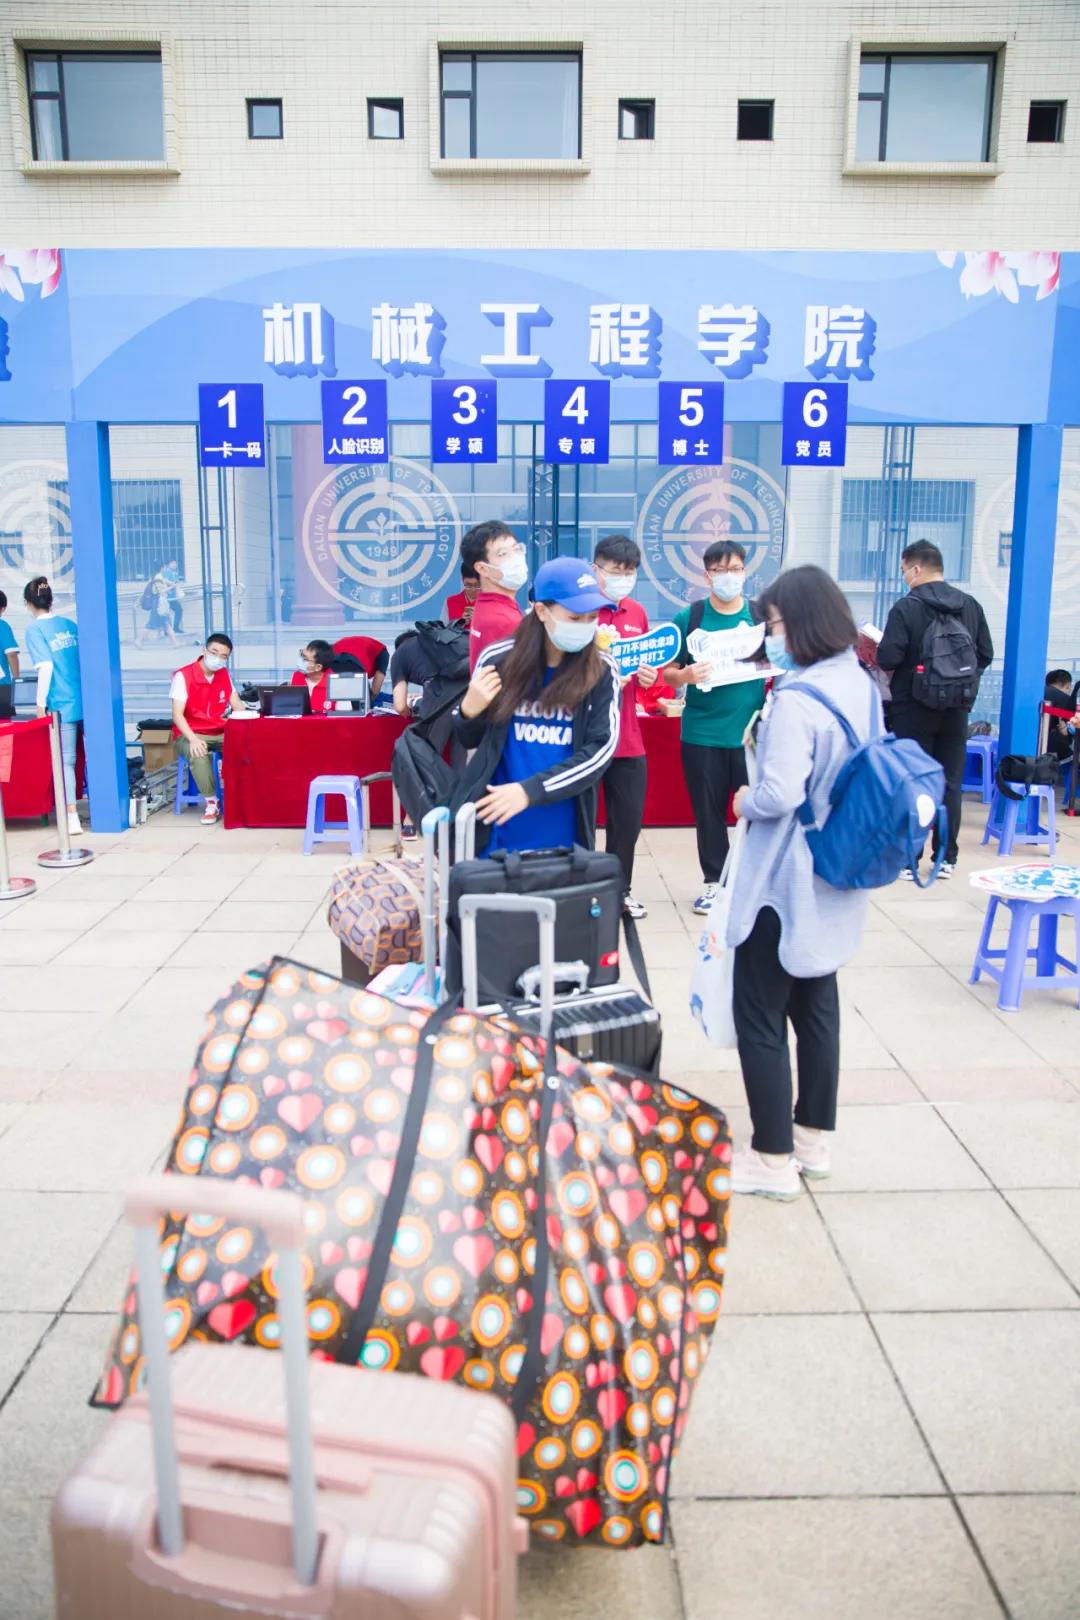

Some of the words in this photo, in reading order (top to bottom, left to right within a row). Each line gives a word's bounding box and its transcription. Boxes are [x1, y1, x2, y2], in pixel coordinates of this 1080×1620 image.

[262, 302, 866, 369] 机械工程学院
[217, 389, 237, 429] 1
[342, 386, 369, 425] 2
[452, 385, 478, 425] 3
[562, 385, 589, 425] 4
[678, 387, 705, 427] 5
[803, 388, 829, 428] 6
[204, 441, 262, 459] 一卡一码
[327, 438, 385, 455] 人脸识别
[445, 437, 483, 455] 学硕
[558, 437, 596, 455] 专硕
[672, 438, 710, 457] 博士
[796, 439, 832, 458] 党员
[321, 465, 386, 508] UNIVERSITY
[395, 468, 411, 481] OF
[648, 513, 662, 563] DALIAN
[657, 465, 723, 509] UNIVERSITY
[731, 468, 750, 482] OF
[751, 479, 784, 563] TECHNOLOGY
[314, 515, 329, 562] DALIAN
[366, 546, 398, 558] 1949
